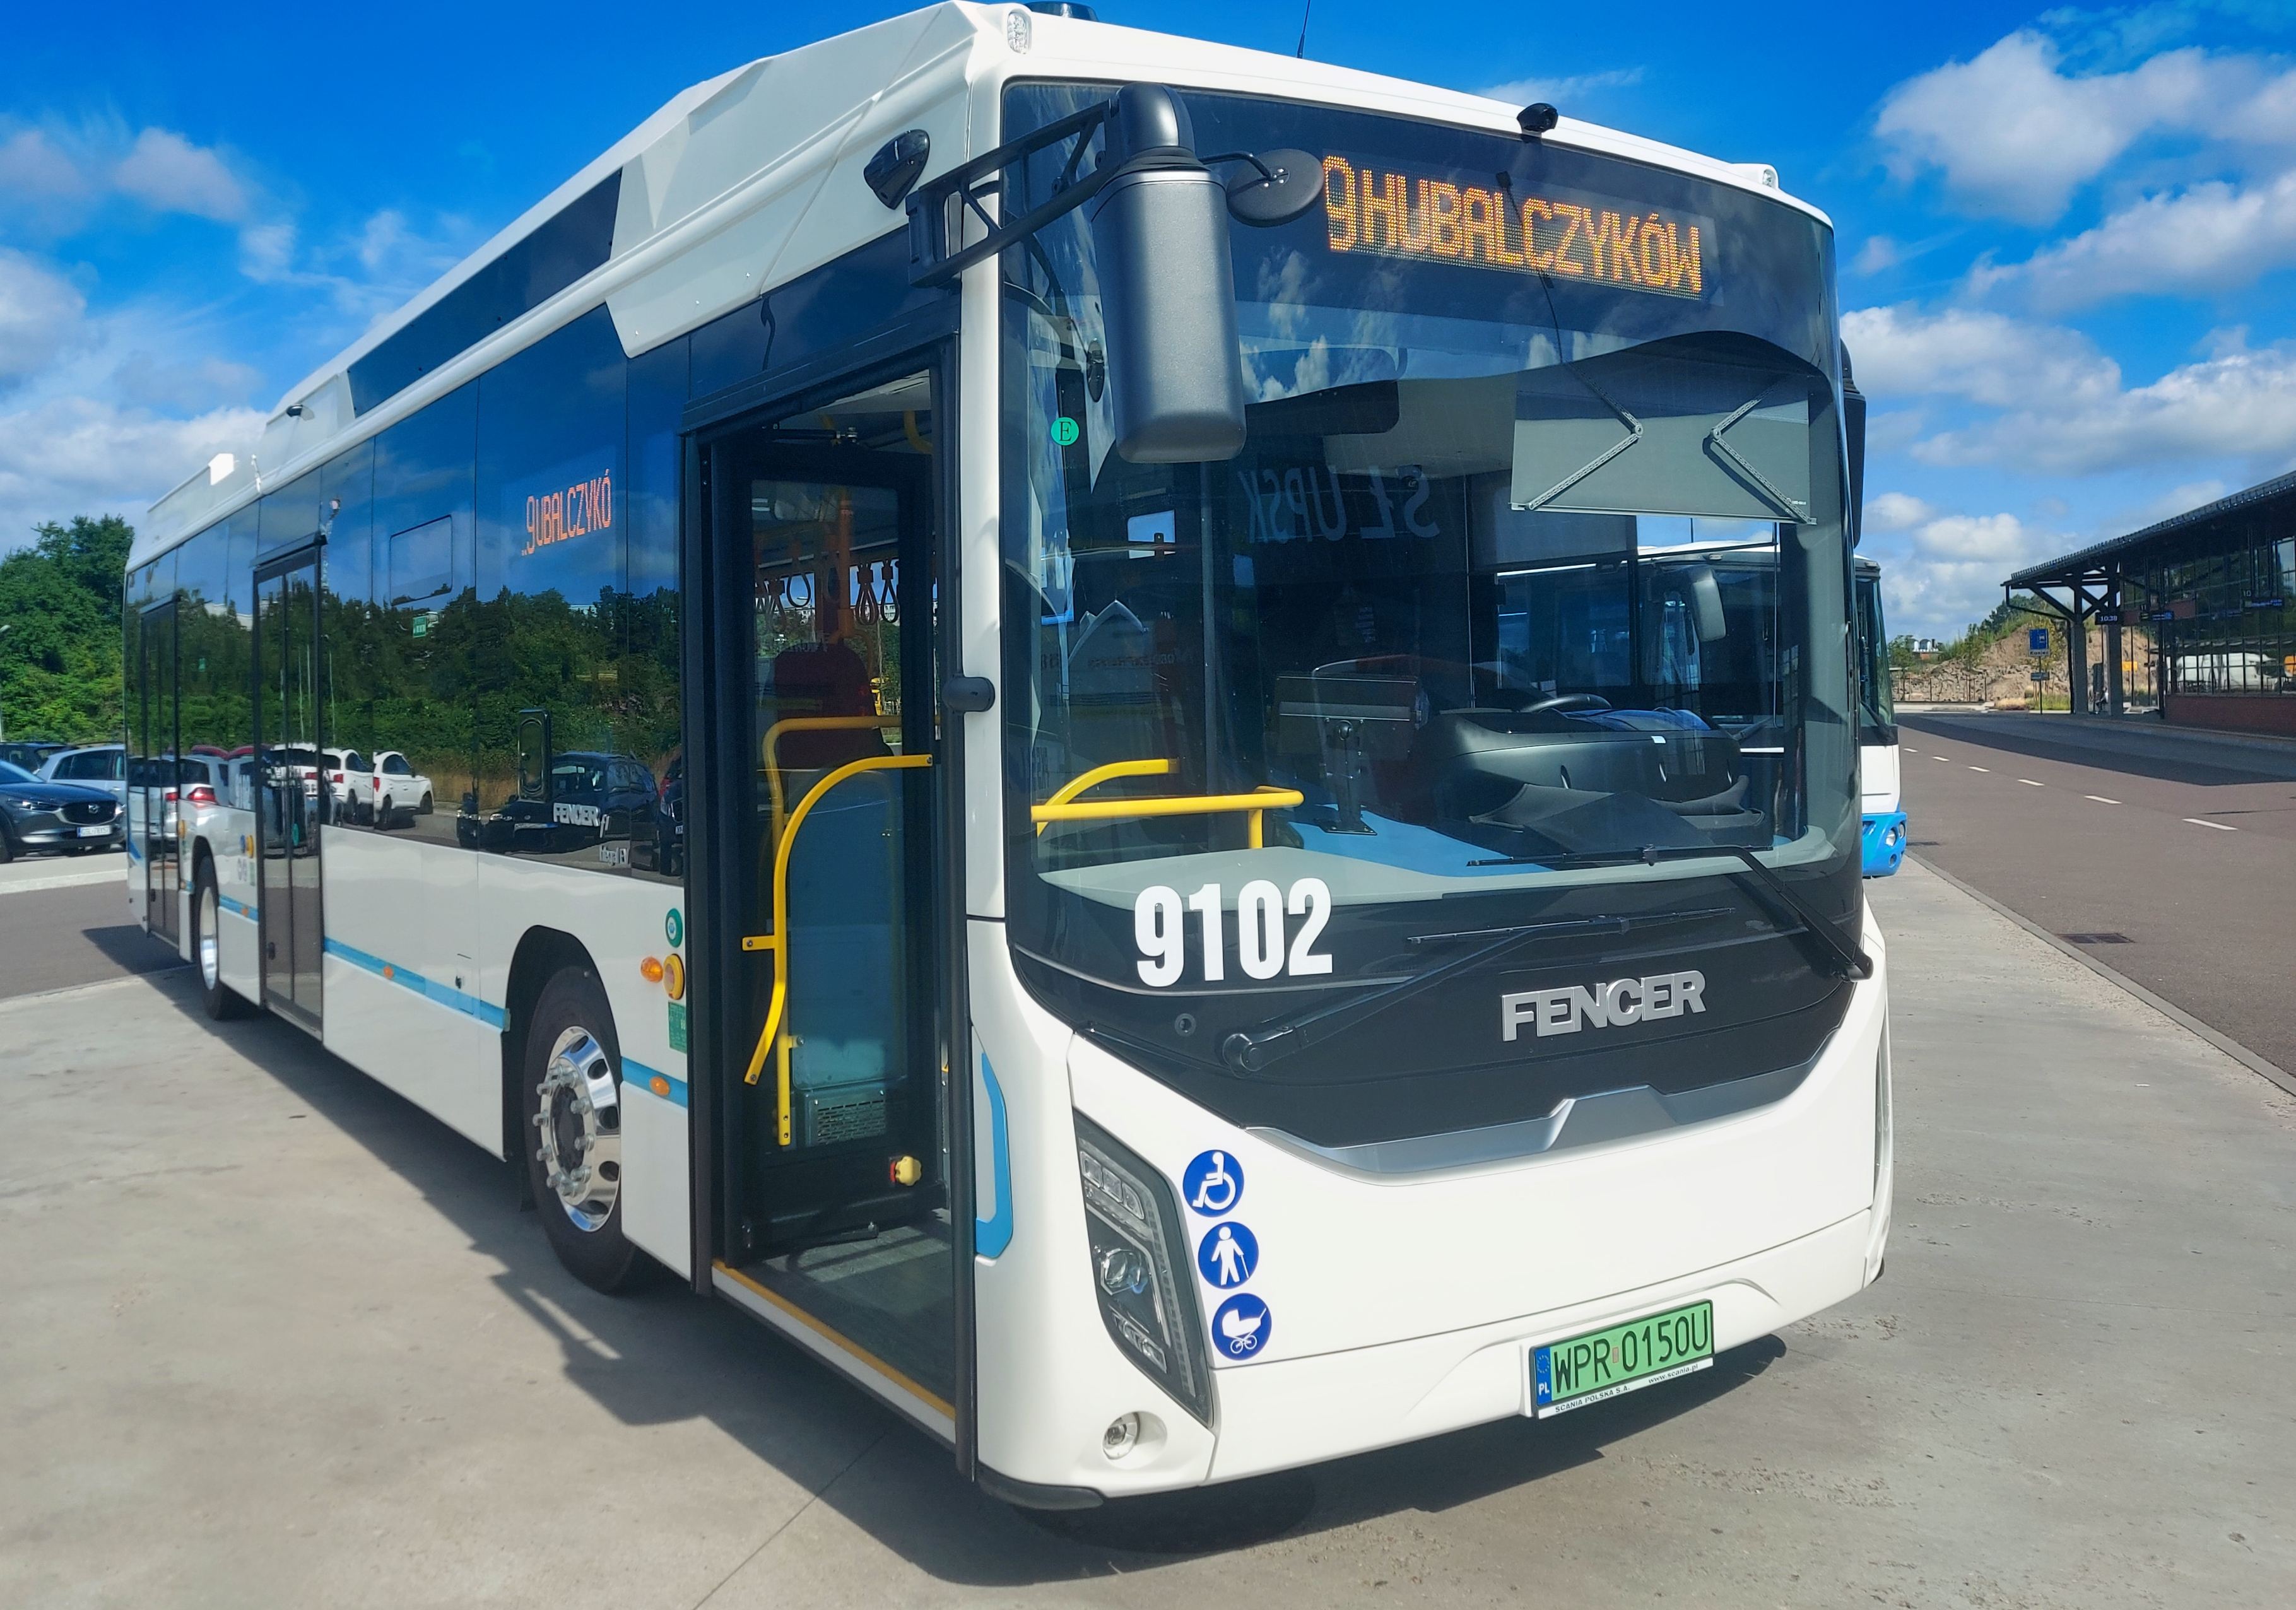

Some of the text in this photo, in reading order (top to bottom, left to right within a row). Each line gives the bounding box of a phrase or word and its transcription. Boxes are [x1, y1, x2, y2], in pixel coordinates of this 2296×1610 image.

[1322, 155, 1703, 293] 9 HUBALCZYKÓW
[1059, 421, 1072, 442] E
[553, 802, 600, 826] FENCER
[1134, 878, 1333, 987] 9102
[1502, 970, 1706, 1042] FENCER
[1553, 1309, 1709, 1394] WPR 0150U
[1538, 1382, 1551, 1396] PL
[1555, 1399, 1583, 1413] SCANIA
[1584, 1390, 1615, 1405] POLSKA
[1648, 1363, 1698, 1384] www.scania.pl
